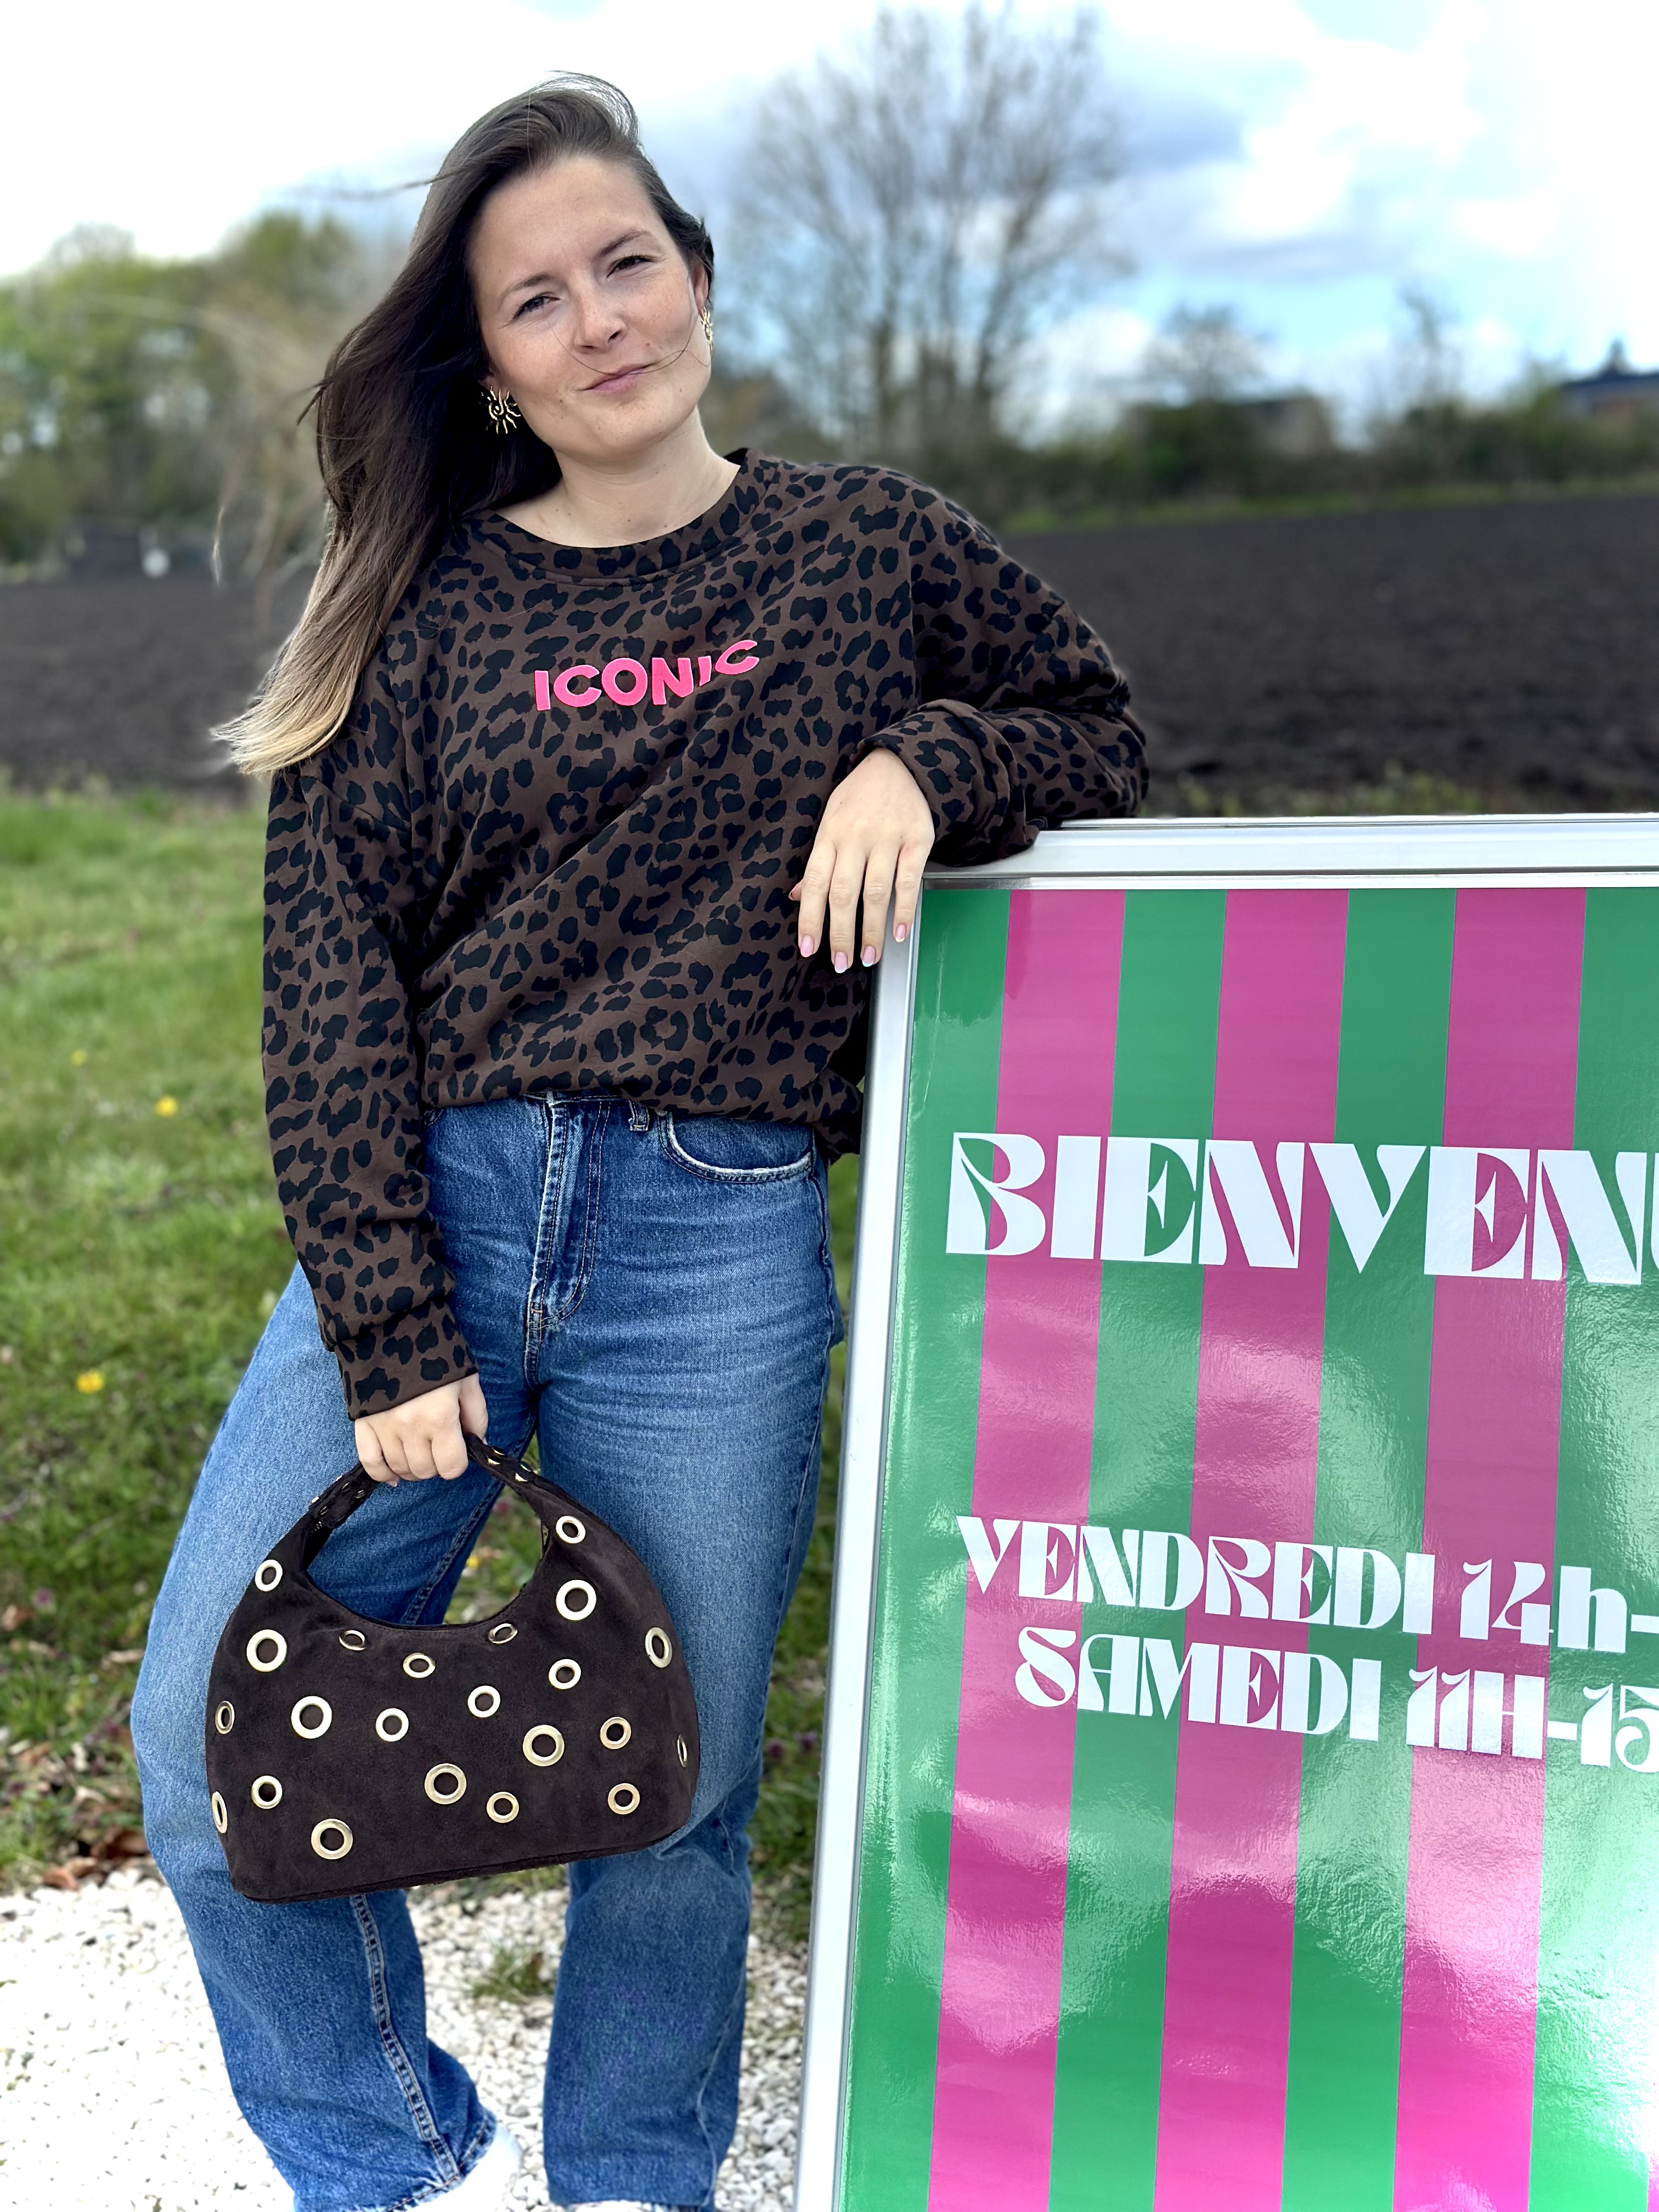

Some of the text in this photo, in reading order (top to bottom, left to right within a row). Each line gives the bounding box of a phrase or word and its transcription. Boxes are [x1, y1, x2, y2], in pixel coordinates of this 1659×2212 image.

[533, 639, 760, 712] ICONIC
[945, 1131, 1659, 1285] BIENVEN
[956, 1515, 1436, 1635] VENDREDI
[1014, 1626, 1381, 1741] SAMEDI
